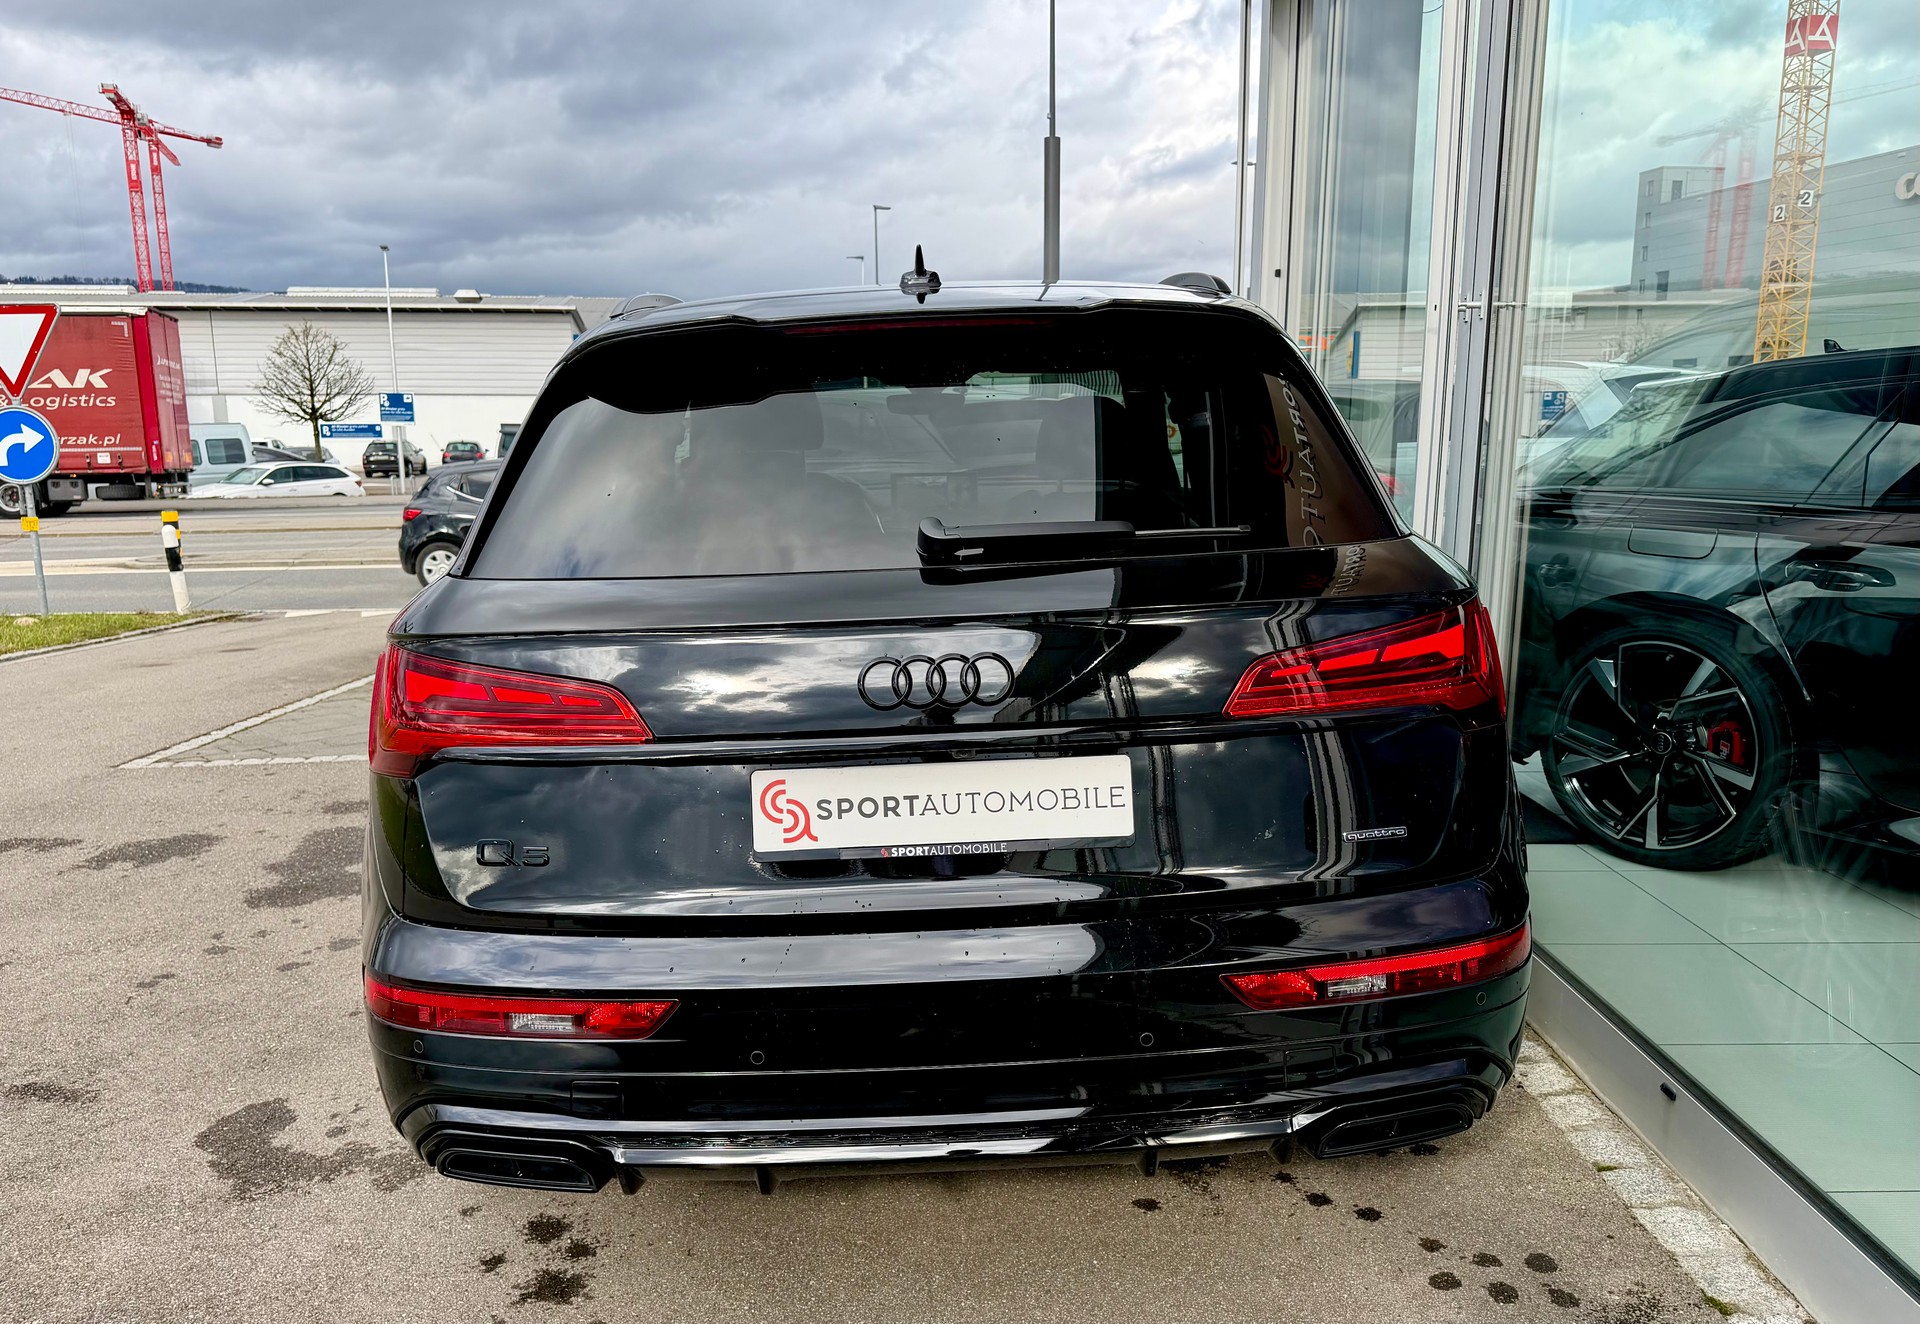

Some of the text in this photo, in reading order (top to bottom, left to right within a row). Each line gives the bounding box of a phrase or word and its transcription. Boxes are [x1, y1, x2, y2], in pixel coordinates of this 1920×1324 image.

[1799, 191, 1811, 205] 2
[1775, 206, 1783, 220] 2
[27, 368, 113, 389] AK
[816, 785, 1126, 821] SPORTAUTOMOBILE
[1347, 828, 1405, 841] quattro
[476, 838, 550, 866] Q5
[891, 842, 1008, 858] SPORTAUTOMOBILE
